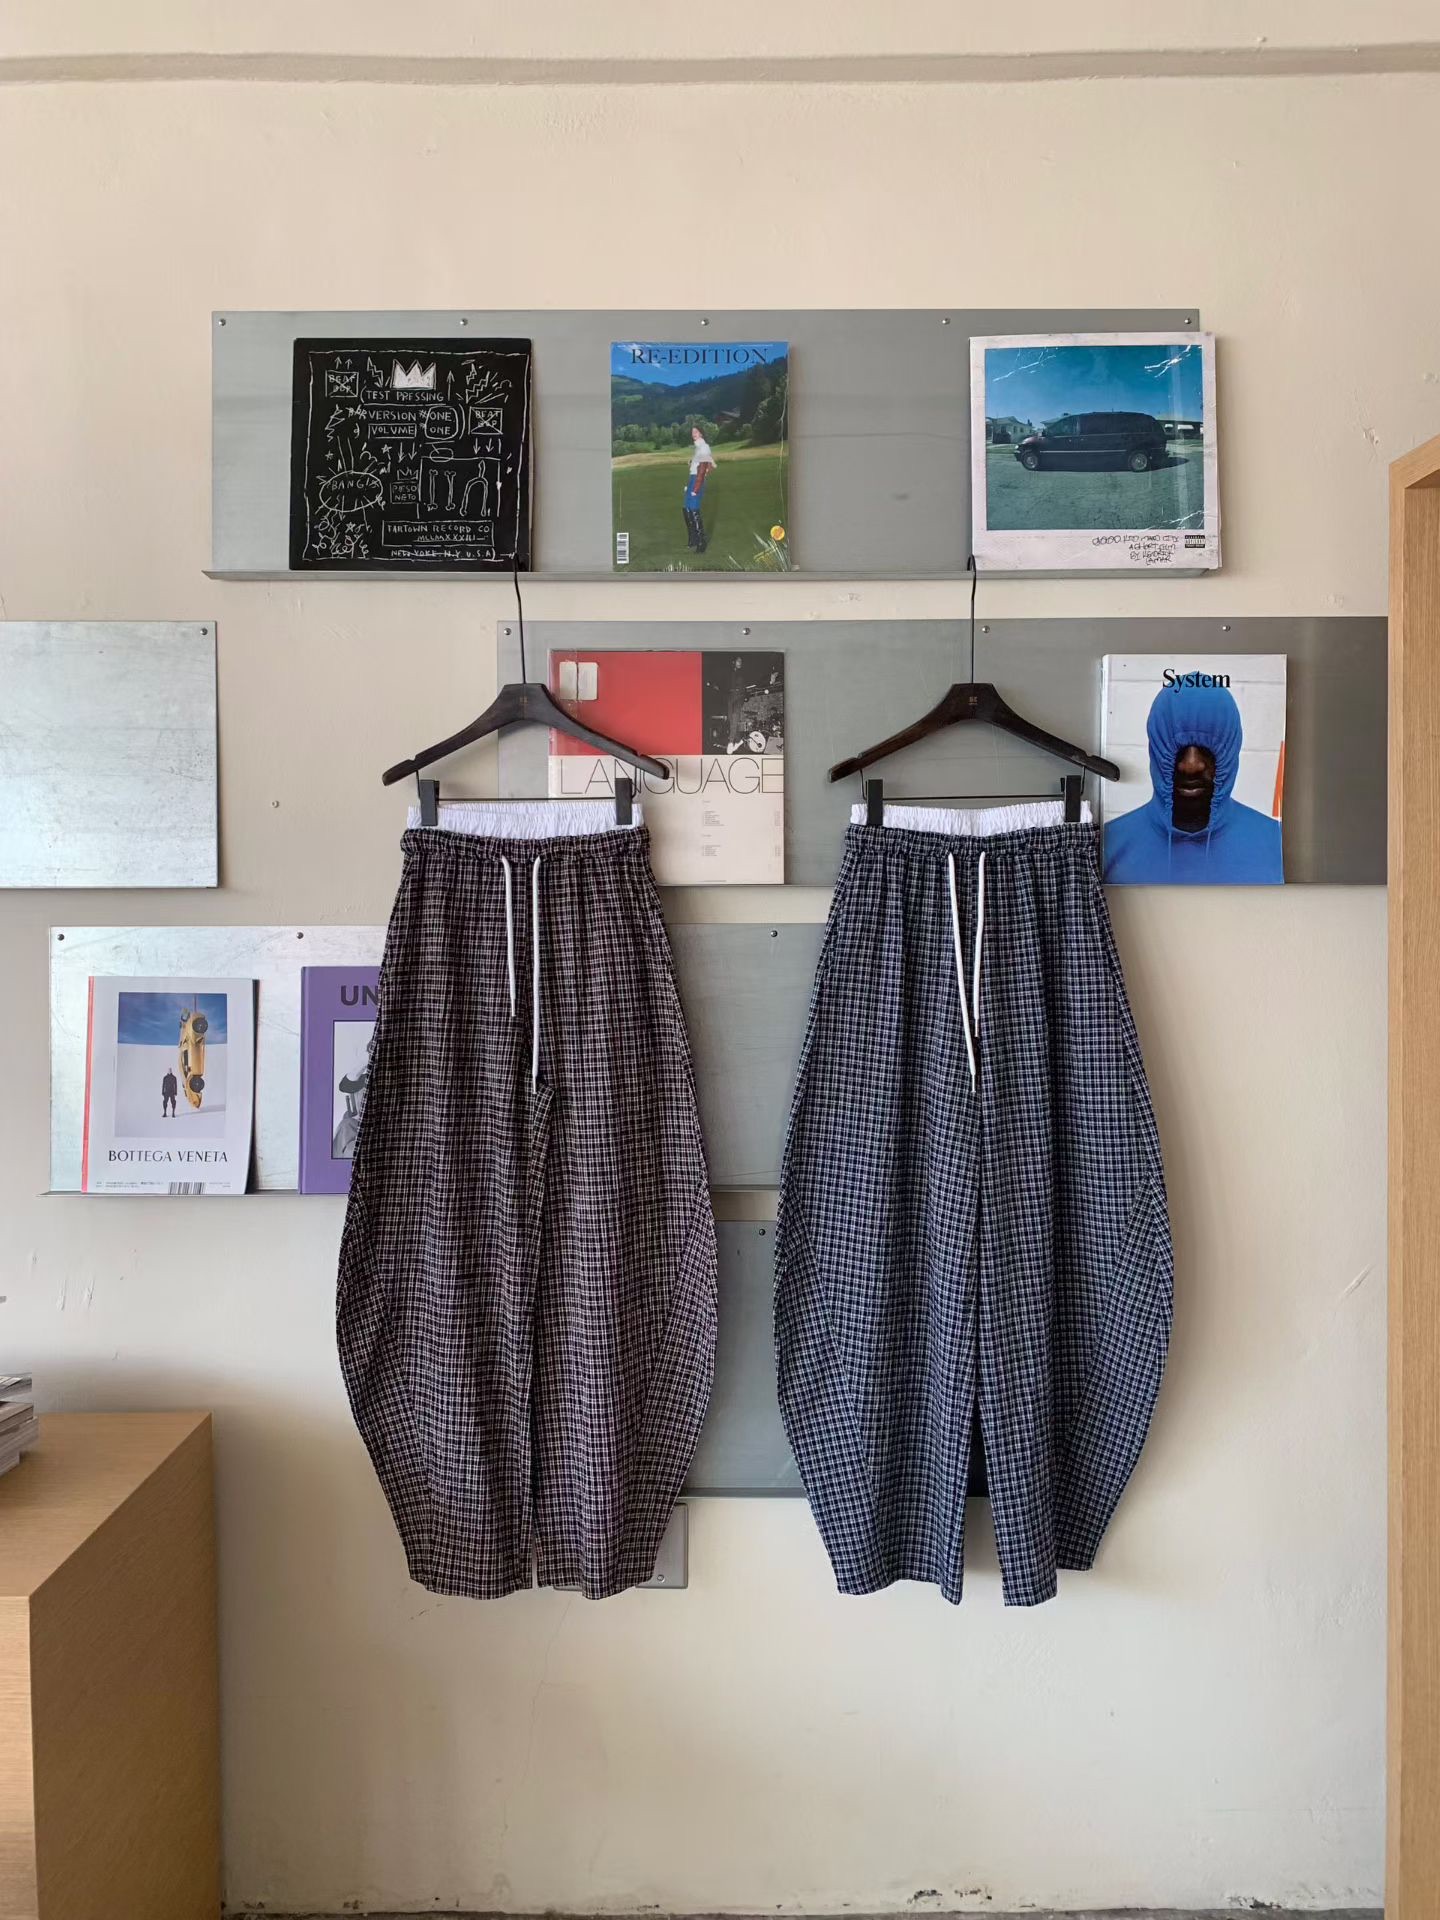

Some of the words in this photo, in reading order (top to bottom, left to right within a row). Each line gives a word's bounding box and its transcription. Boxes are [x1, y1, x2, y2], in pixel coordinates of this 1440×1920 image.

[631, 348, 768, 365] RE-EDITION
[366, 390, 390, 401] TEST
[396, 390, 444, 402] PRESSING
[368, 410, 416, 421] VERSION
[371, 426, 414, 435] VOLUME
[388, 524, 428, 533] TARTOWN
[433, 524, 472, 533] RECORD
[1162, 668, 1231, 693] System
[108, 1149, 172, 1162] BOTTEGA
[177, 1150, 228, 1163] VENETA
